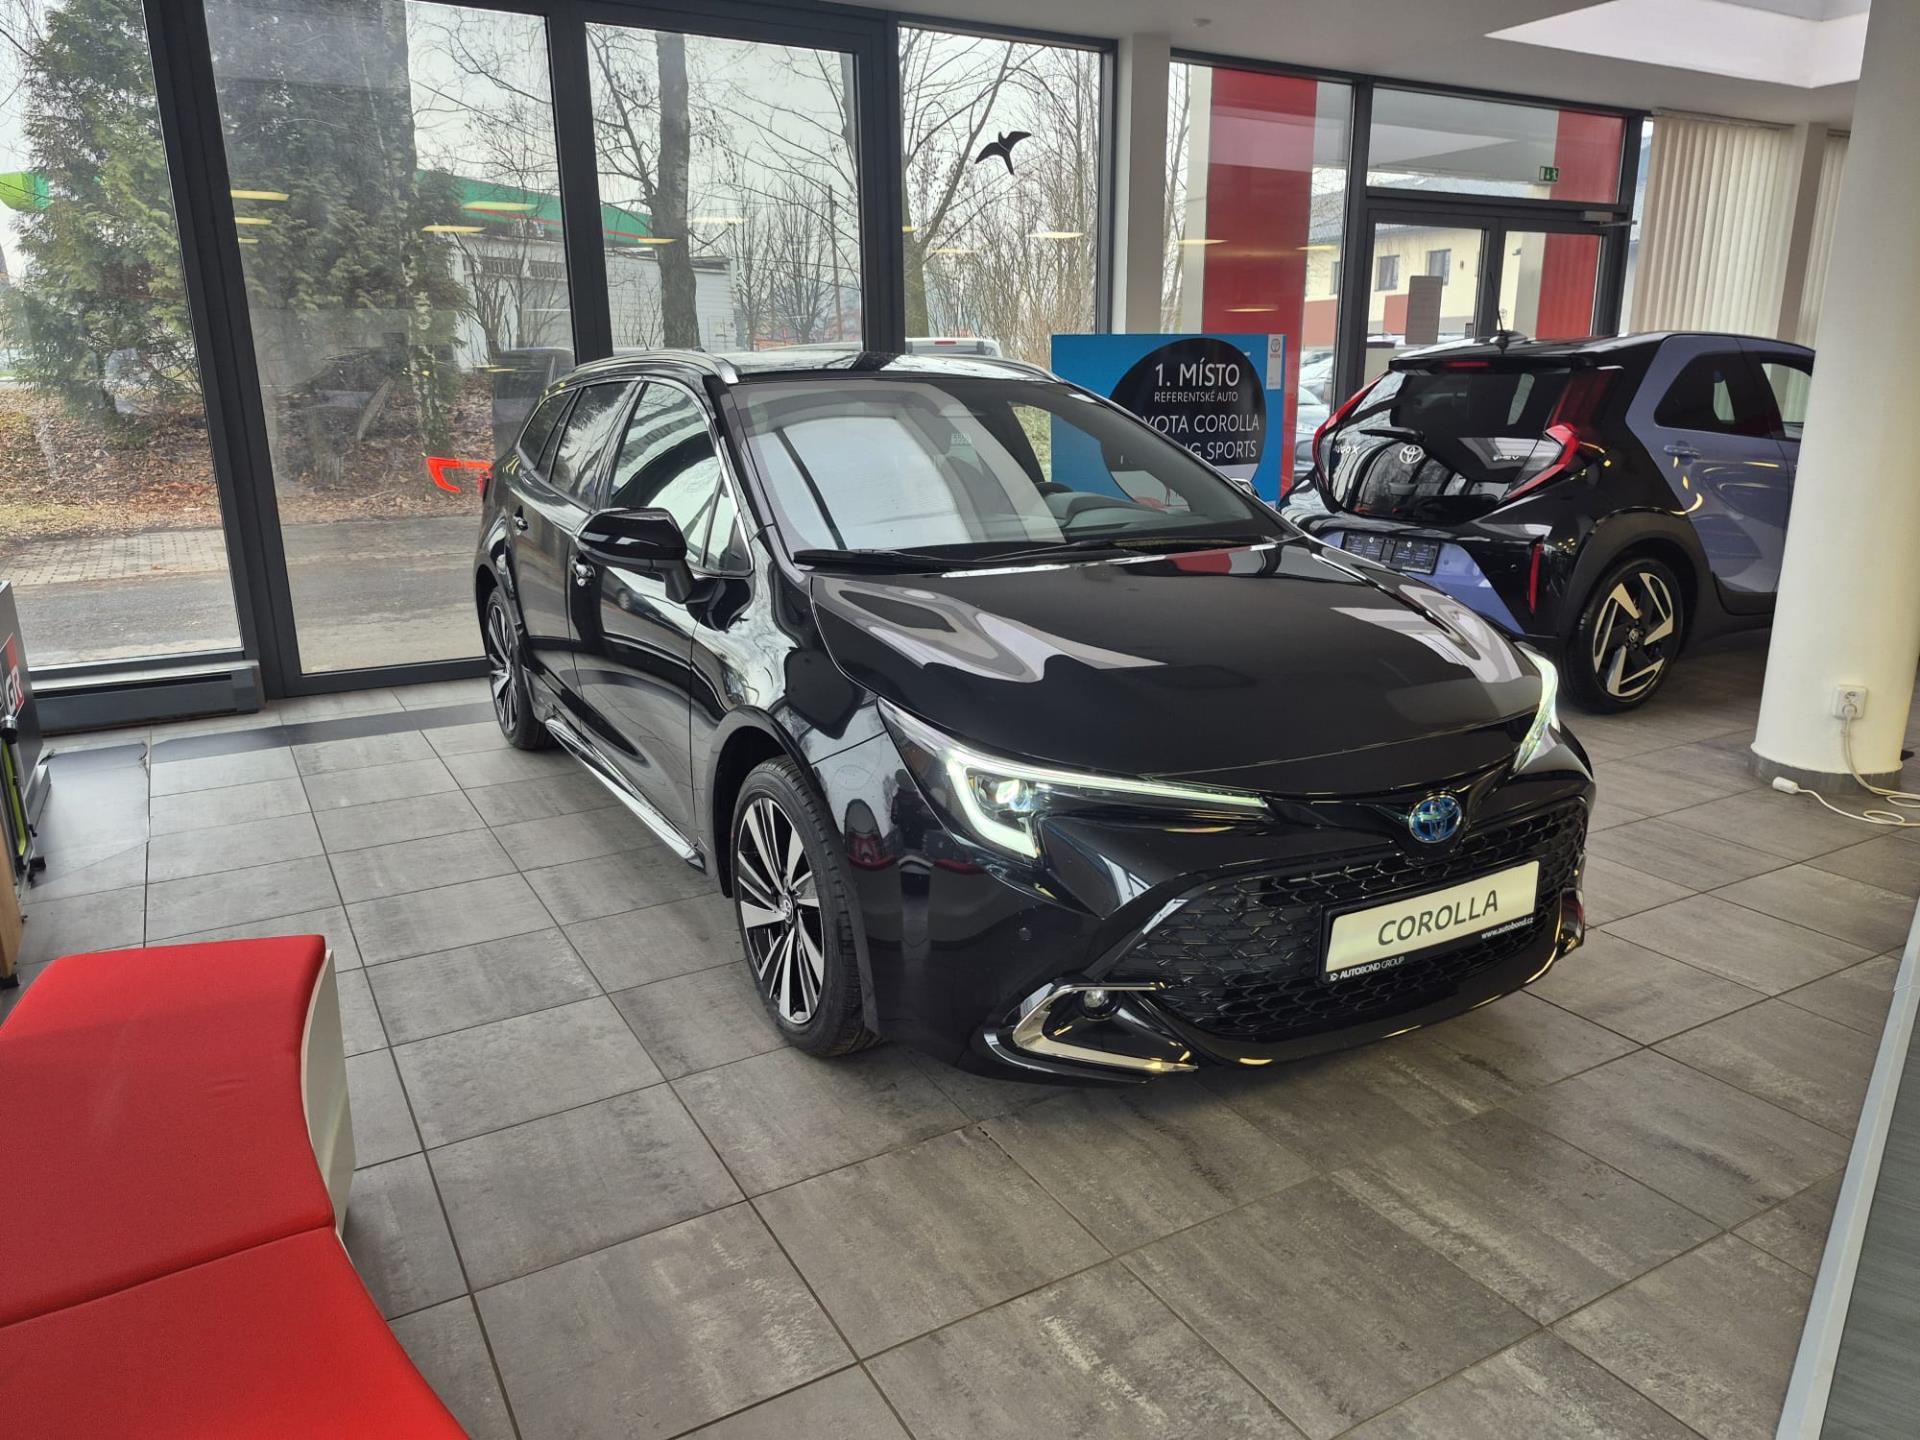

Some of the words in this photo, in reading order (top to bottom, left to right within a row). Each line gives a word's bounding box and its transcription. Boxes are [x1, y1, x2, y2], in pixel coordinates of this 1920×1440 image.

[1155, 363, 1171, 387] 1.
[1179, 356, 1240, 387] MÍSTO
[1154, 390, 1216, 403] REFERENTSKÉ
[1216, 391, 1239, 402] AUTO
[1142, 415, 1189, 434] YOTA
[1193, 413, 1260, 433] COROLLA
[1206, 440, 1257, 460] SPORTS
[1378, 889, 1498, 946] COROLLA
[1340, 962, 1381, 979] AUTOBOND
